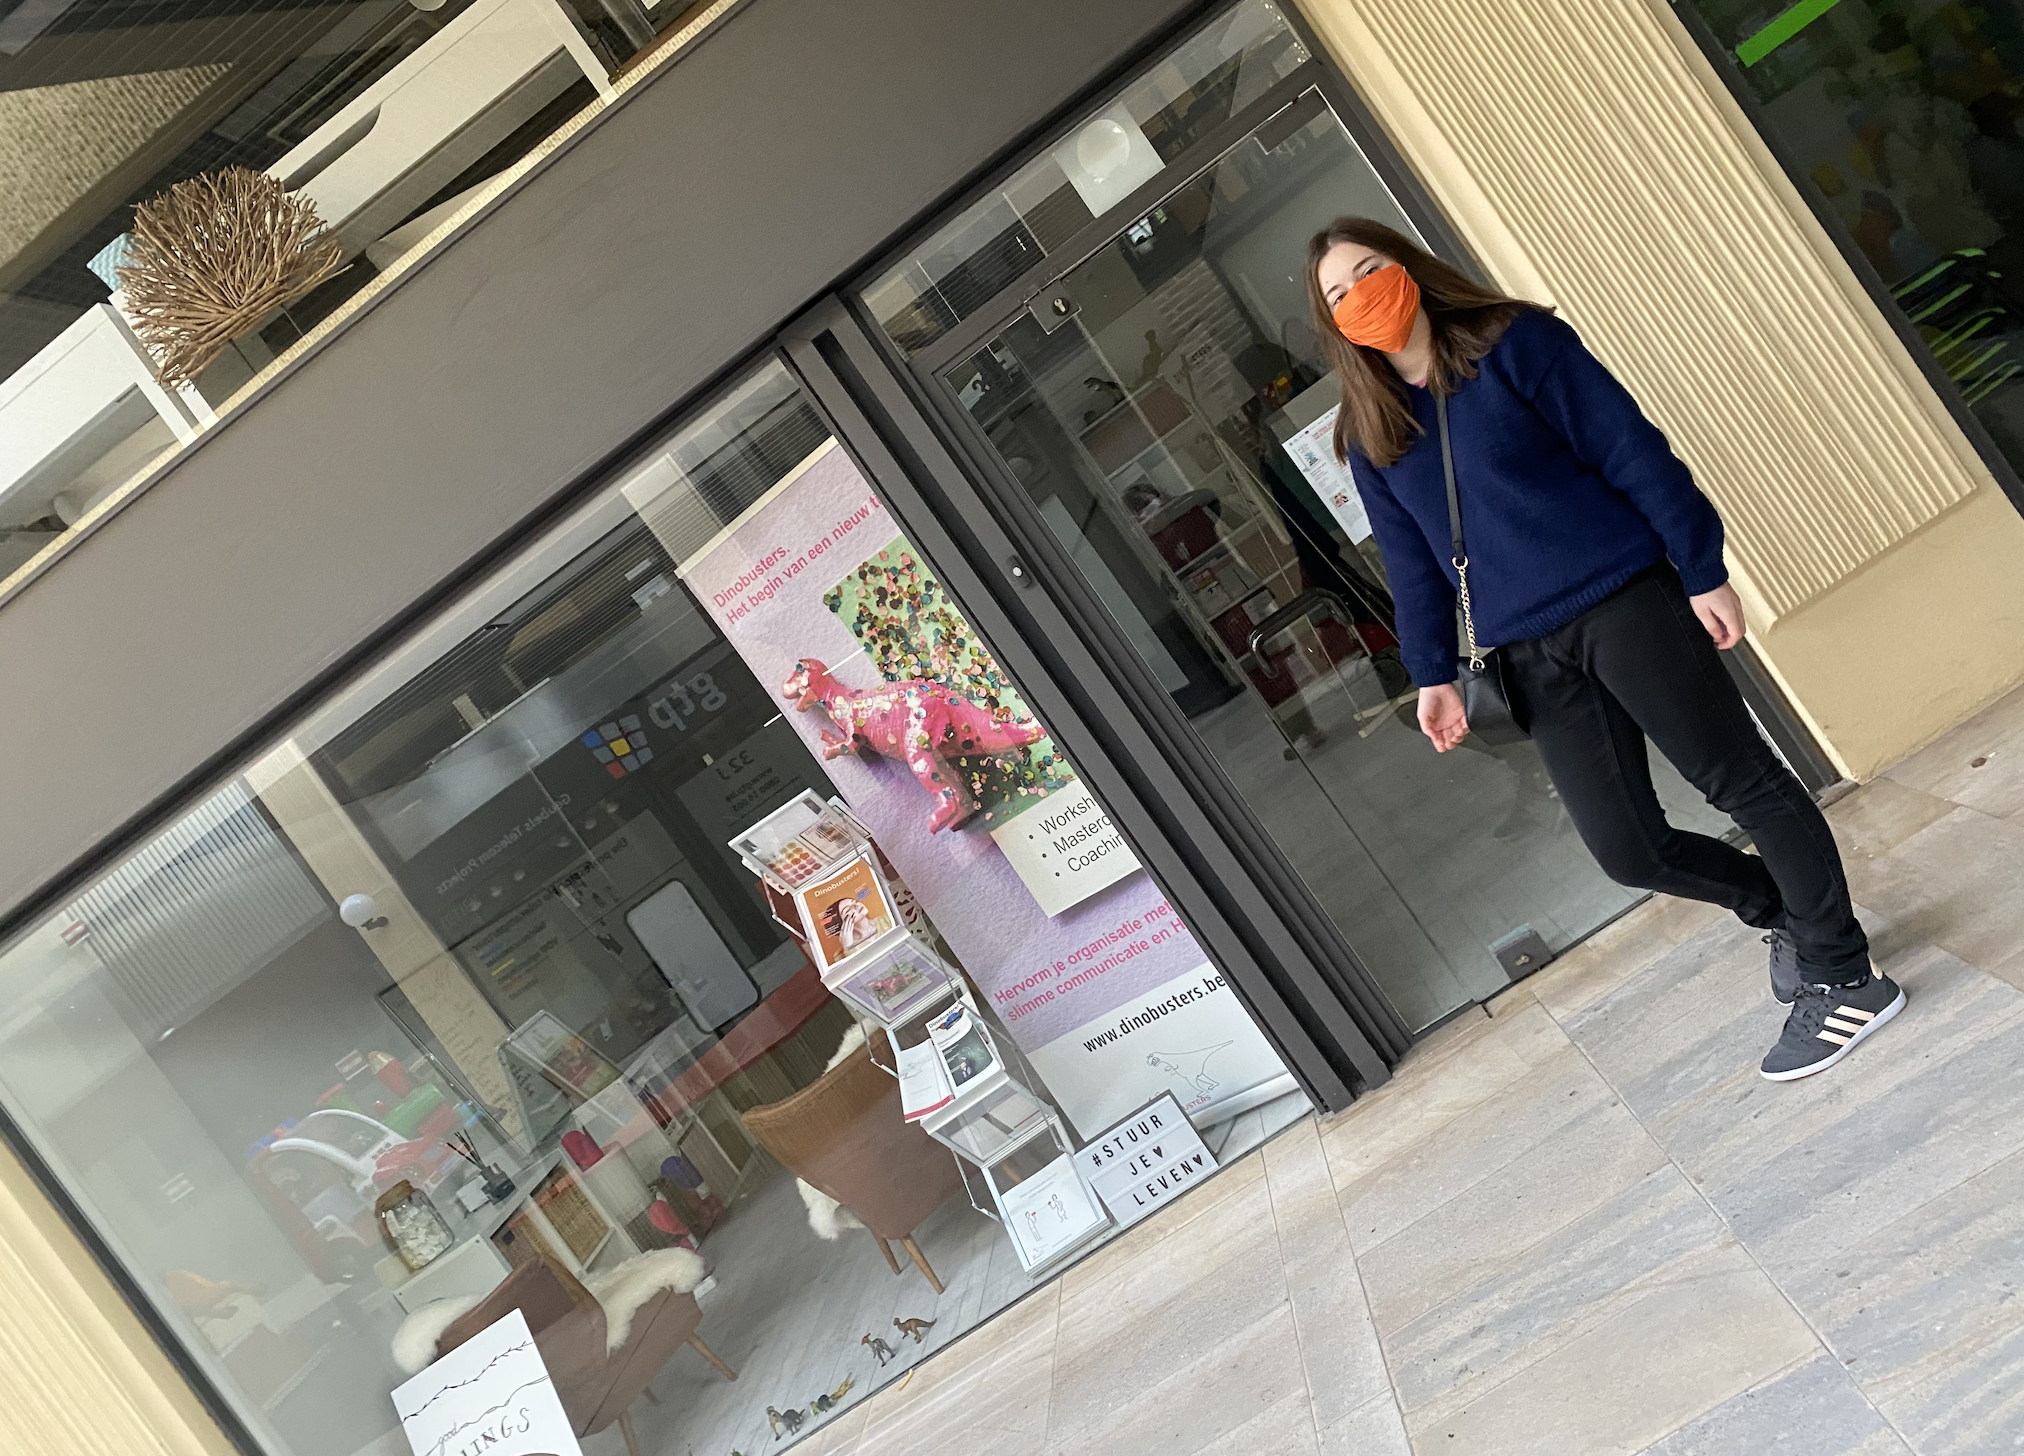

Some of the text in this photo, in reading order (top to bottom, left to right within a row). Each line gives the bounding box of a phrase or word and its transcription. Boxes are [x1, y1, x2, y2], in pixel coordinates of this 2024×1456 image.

[713, 545, 791, 608] Dinobusters.
[726, 603, 750, 625] Het
[749, 575, 784, 608] begin
[782, 556, 808, 580] van
[807, 537, 832, 560] een
[832, 505, 870, 540] nieuw
[1038, 797, 1096, 835] Worksh
[813, 867, 860, 898] Dinobusters!
[993, 900, 1173, 1006] Hervorm je organisatie met
[1007, 917, 1186, 1022] slimme communicatie en H
[1083, 974, 1227, 1053] www.dinobusters.be
[1092, 1114, 1163, 1167] #STUUR
[1132, 1160, 1194, 1206] LEVEN
